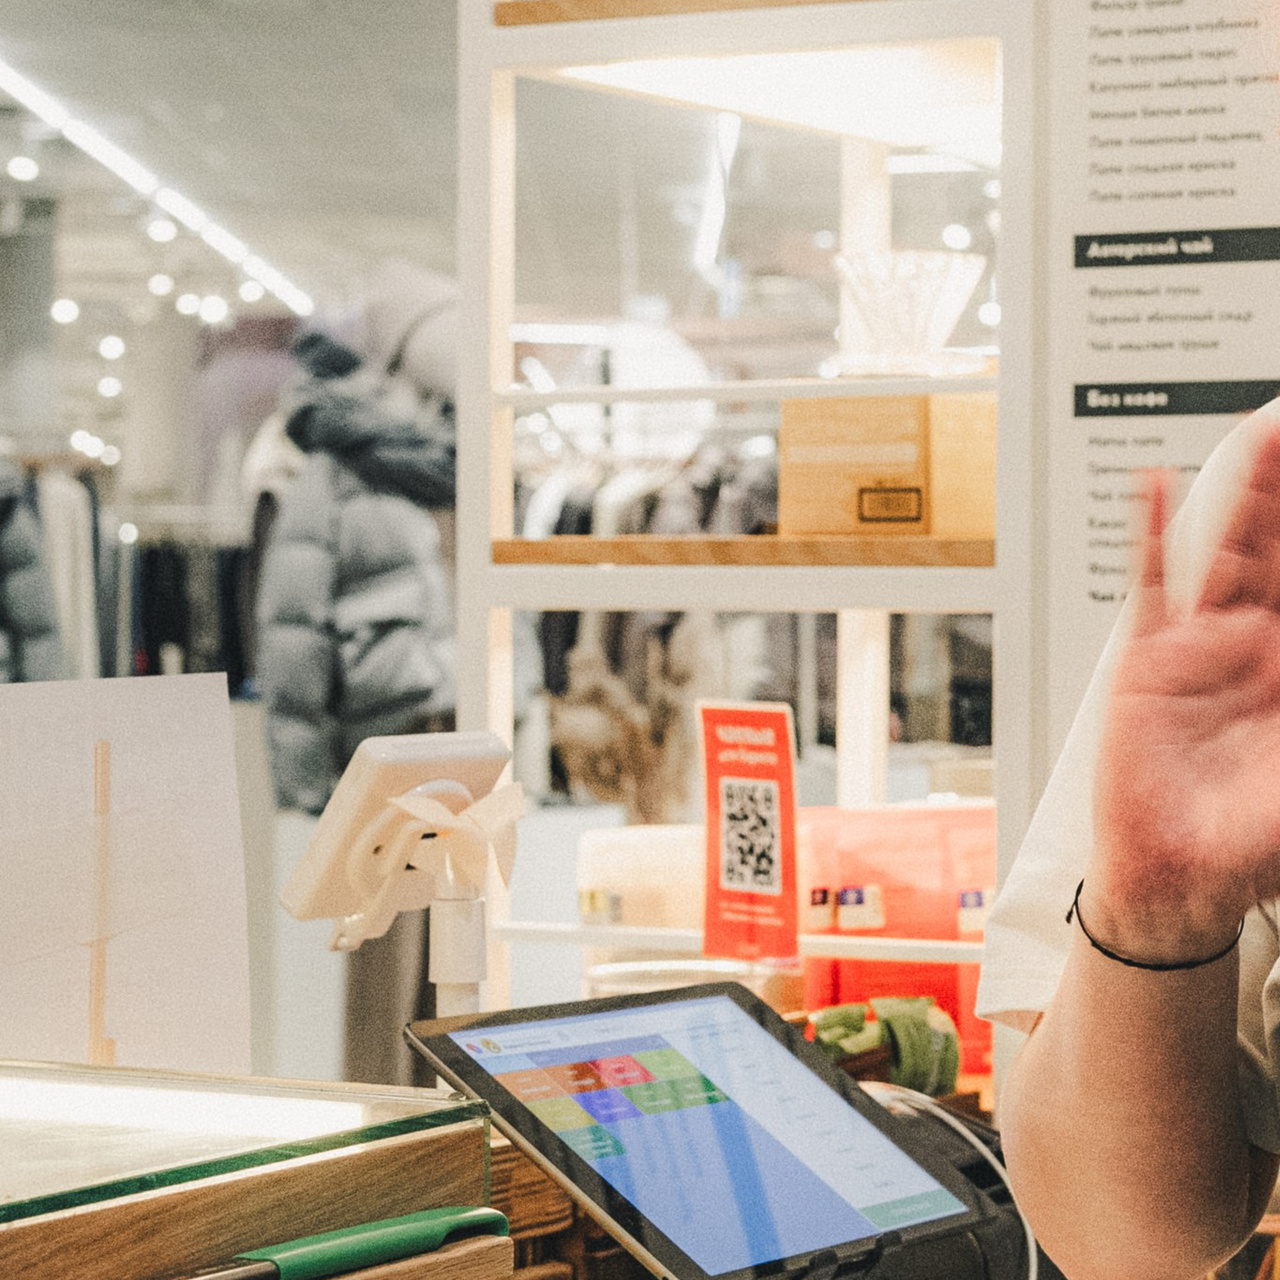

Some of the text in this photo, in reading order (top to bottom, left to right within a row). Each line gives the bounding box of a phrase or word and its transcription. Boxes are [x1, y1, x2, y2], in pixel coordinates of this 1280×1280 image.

[1086, 238, 1176, 260] Авторский
[1181, 237, 1211, 254] чай
[1087, 390, 1167, 407] Без кофе
